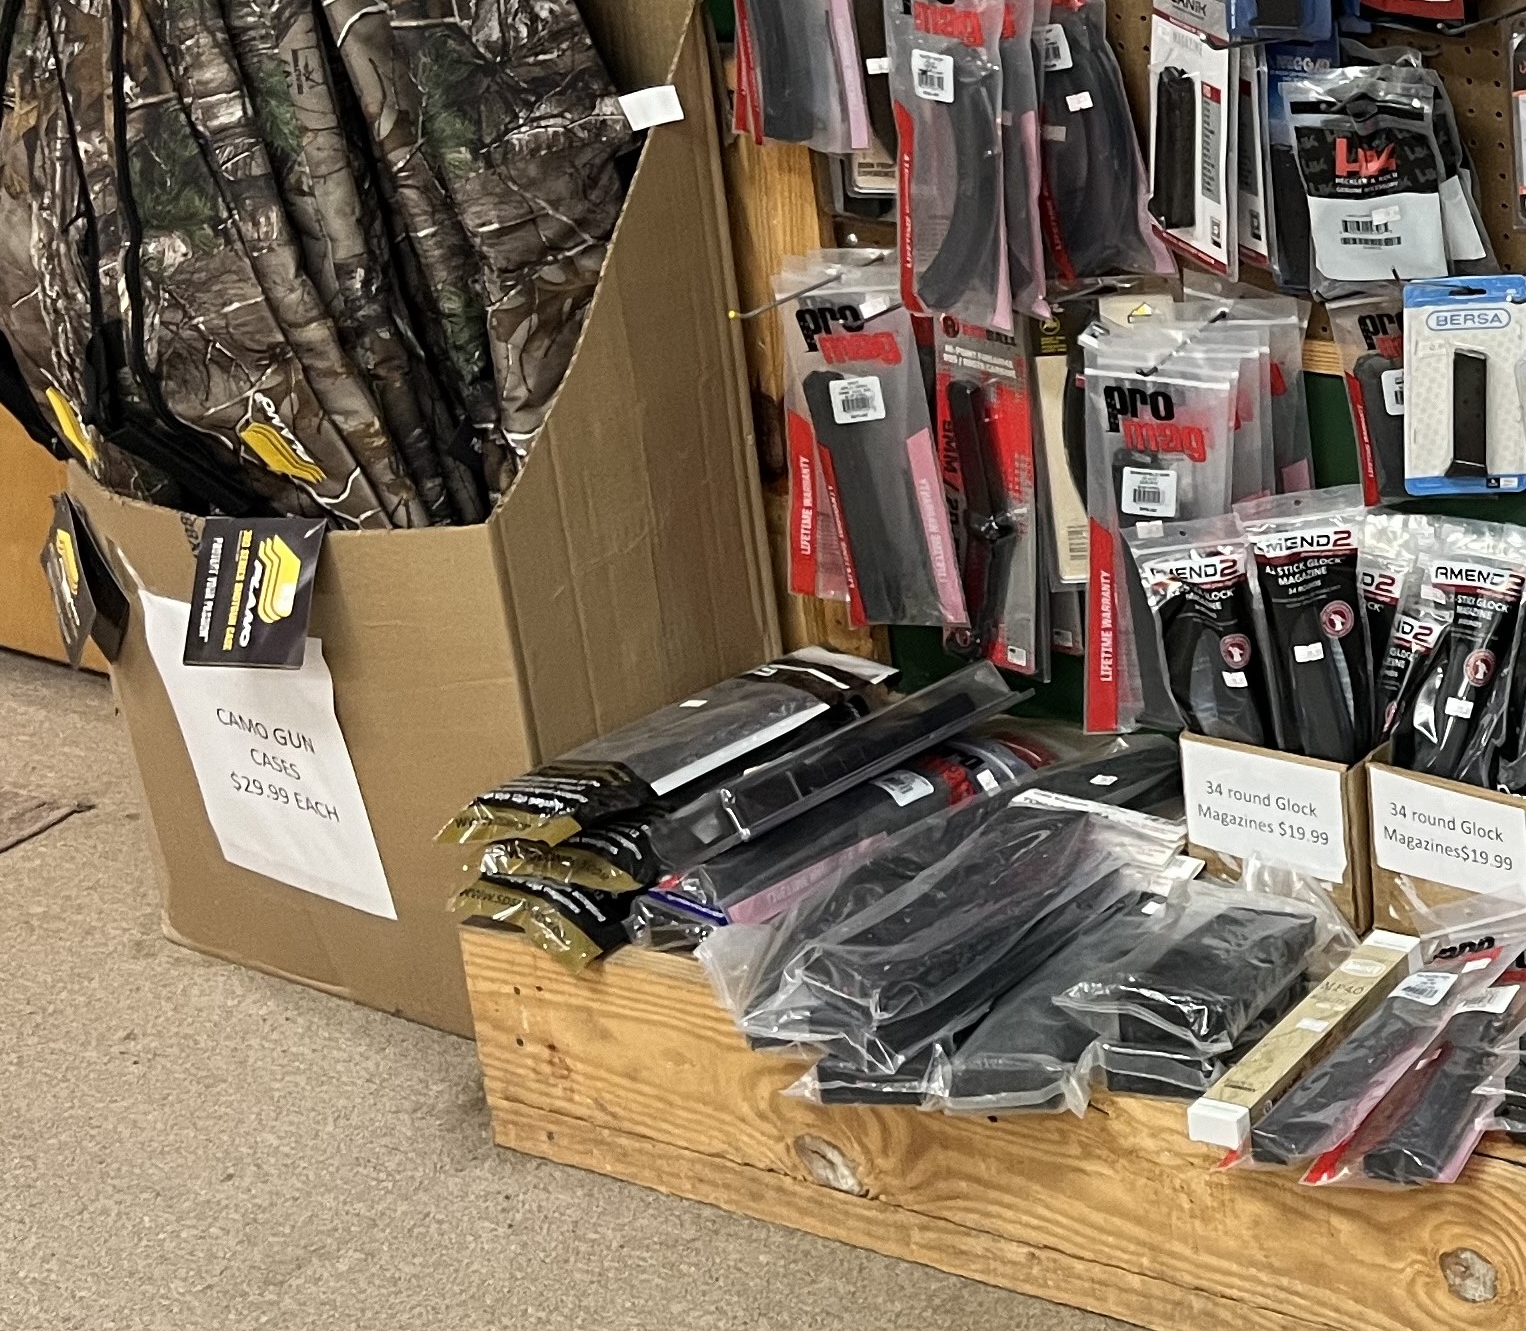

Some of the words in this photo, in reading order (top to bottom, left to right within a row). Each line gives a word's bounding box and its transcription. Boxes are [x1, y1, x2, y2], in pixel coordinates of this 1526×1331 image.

[1435, 312, 1504, 328] BERSA
[818, 332, 902, 365] mag
[1103, 385, 1175, 433] pro
[1123, 421, 1208, 463] mag
[801, 455, 813, 505] WARRANTY
[801, 508, 813, 555] LIFETIME
[1277, 566, 1328, 586] MAGAZINE
[1306, 556, 1343, 568] GLOCK
[1099, 570, 1110, 623] WARRANTY
[1476, 598, 1509, 613] GLOCK
[1099, 625, 1112, 682] LIFETIME
[216, 707, 269, 743] CAMO
[272, 726, 316, 756] GUN
[249, 747, 302, 782] CASES
[230, 772, 290, 806] $29.99
[293, 791, 339, 824] EACH
[1204, 780, 1224, 798] 34
[1227, 784, 1270, 808] round
[1275, 794, 1318, 819] Glock
[1197, 802, 1275, 836] Magazines
[1277, 818, 1330, 847] $19.99
[1389, 801, 1408, 819] 34
[1411, 806, 1455, 831] round
[1459, 817, 1504, 844] Glock
